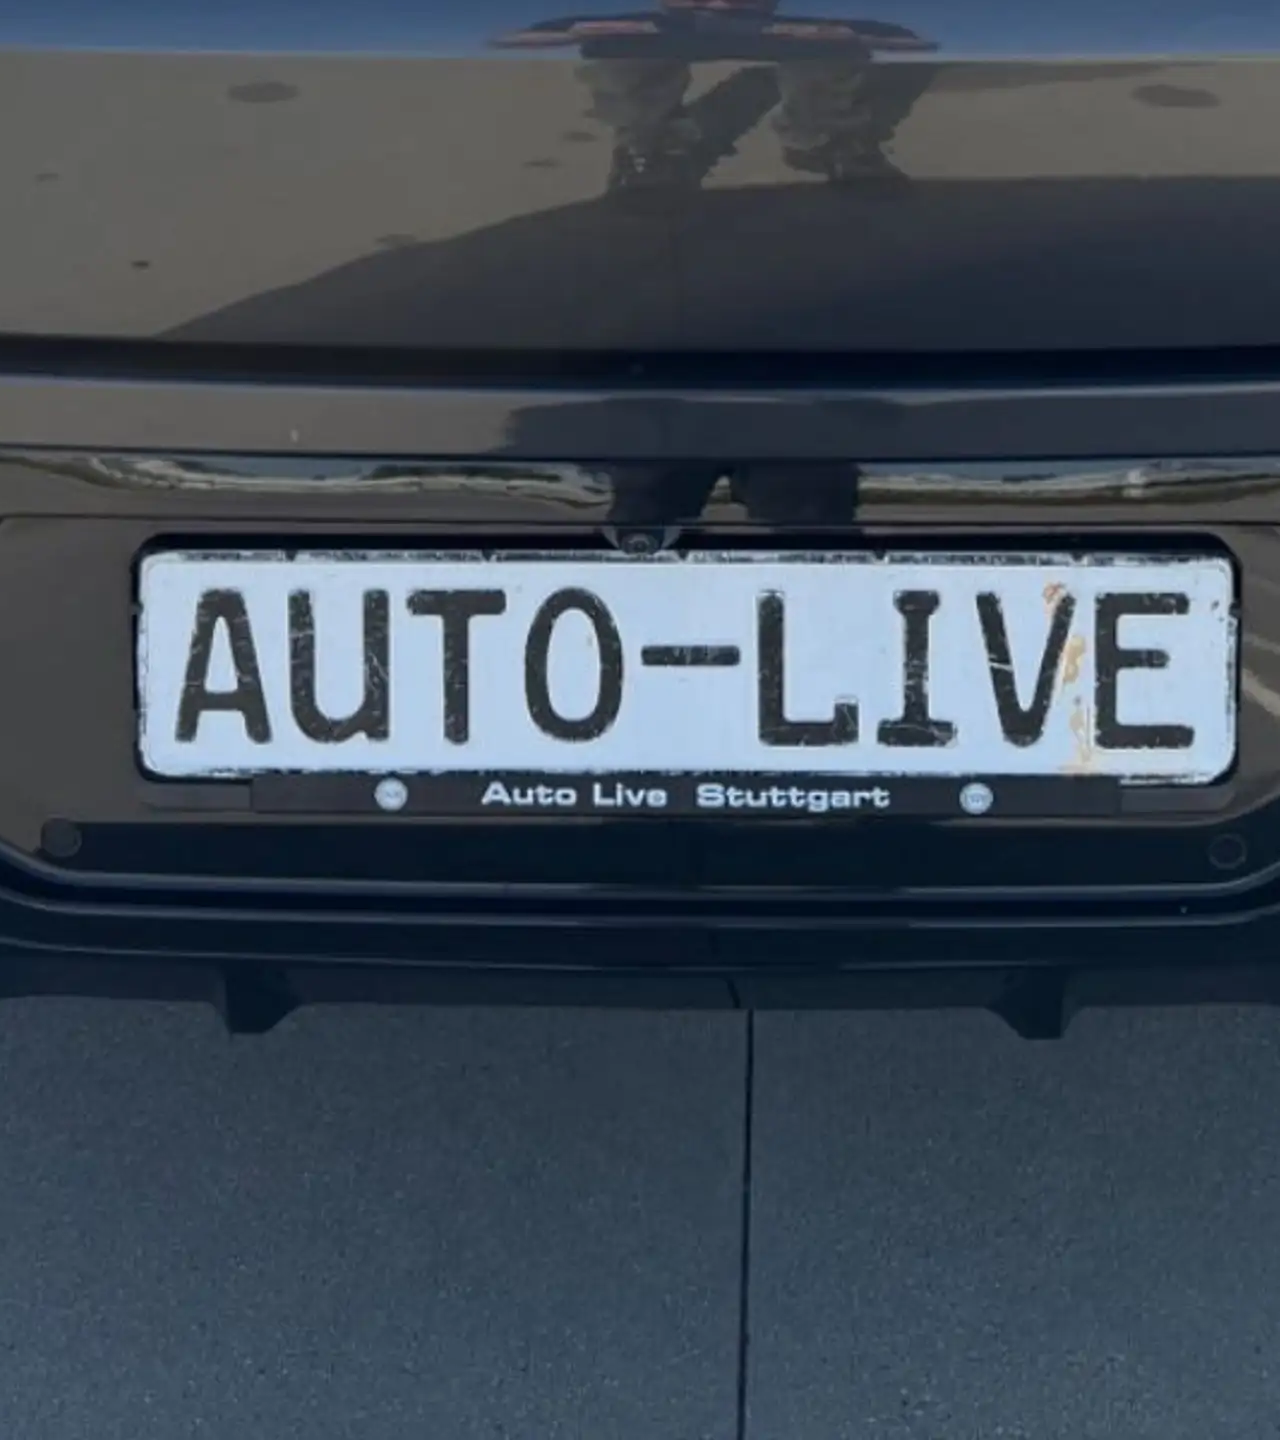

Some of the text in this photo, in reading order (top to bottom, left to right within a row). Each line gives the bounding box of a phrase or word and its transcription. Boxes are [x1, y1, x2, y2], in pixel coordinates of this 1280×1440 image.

[175, 589, 1195, 748] AUTO-LIVE
[480, 782, 891, 814] Auto Live Stuttgart
